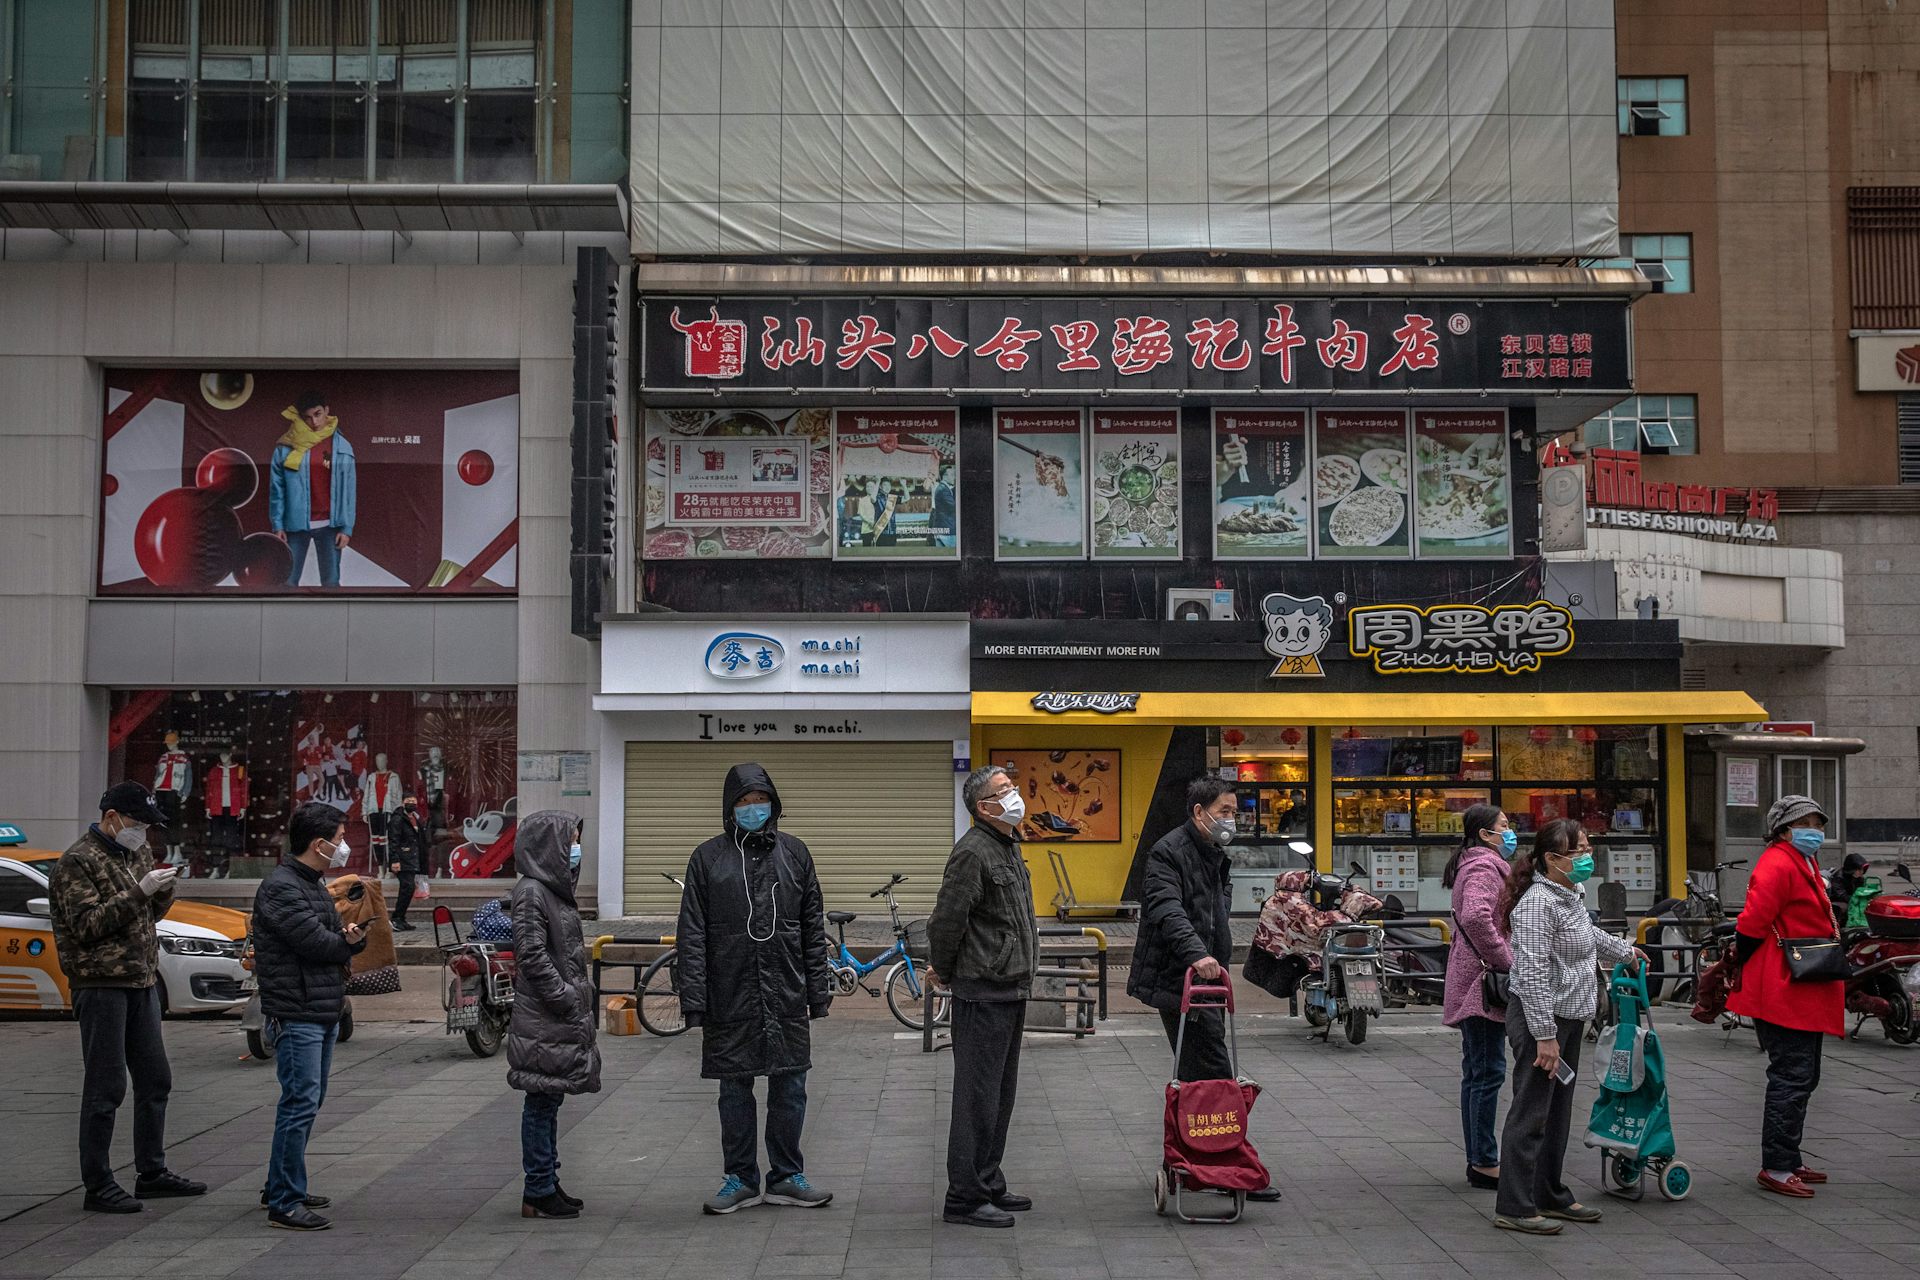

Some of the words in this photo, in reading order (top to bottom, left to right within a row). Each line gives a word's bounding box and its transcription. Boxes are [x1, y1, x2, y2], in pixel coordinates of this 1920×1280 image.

[761, 304, 1439, 384] 汕头八合里海记牛肉店
[1500, 333, 1592, 354] 东贝连锁
[1501, 358, 1593, 378] 江汉路店
[683, 494, 794, 507] 28元就能吃尽荣获中国
[679, 507, 798, 518] 火锅霸中霸的美味全牛宴
[1355, 608, 1569, 650] 周黑鸭
[984, 645, 1015, 655] MORE
[1018, 645, 1102, 656] ENTERTAINMENT
[1106, 646, 1137, 656] MORE
[1138, 646, 1160, 656] FUN
[699, 713, 713, 739] I
[718, 718, 745, 733] love
[754, 721, 777, 735] you
[794, 723, 808, 734] so
[813, 719, 862, 734] machi.
[1196, 1111, 1237, 1126] 胡姬花
